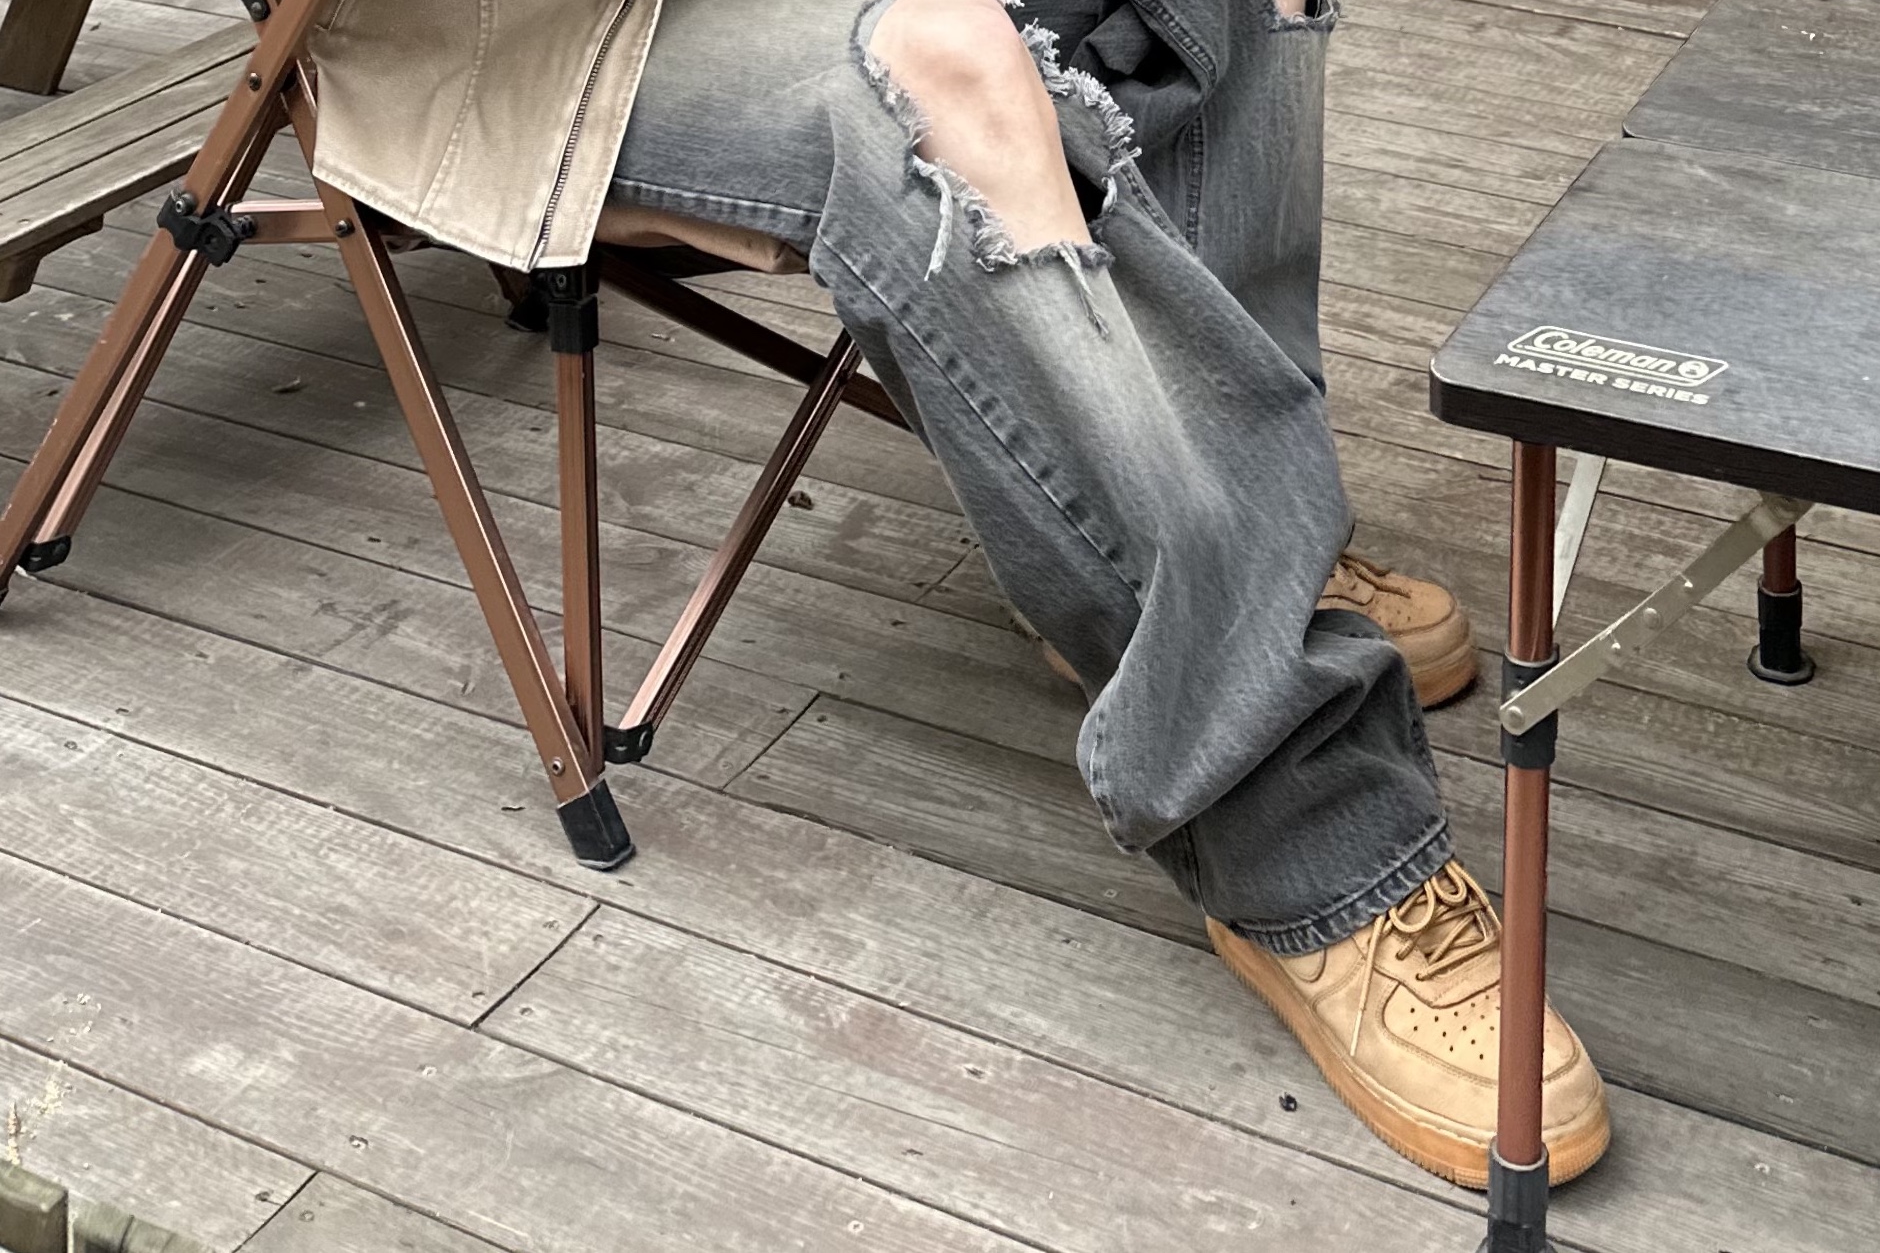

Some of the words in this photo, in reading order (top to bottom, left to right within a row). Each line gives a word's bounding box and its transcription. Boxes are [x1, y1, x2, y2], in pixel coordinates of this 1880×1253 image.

[1532, 331, 1677, 374] Coleman
[1494, 353, 1608, 386] MASTER
[1611, 376, 1711, 406] SERIES
